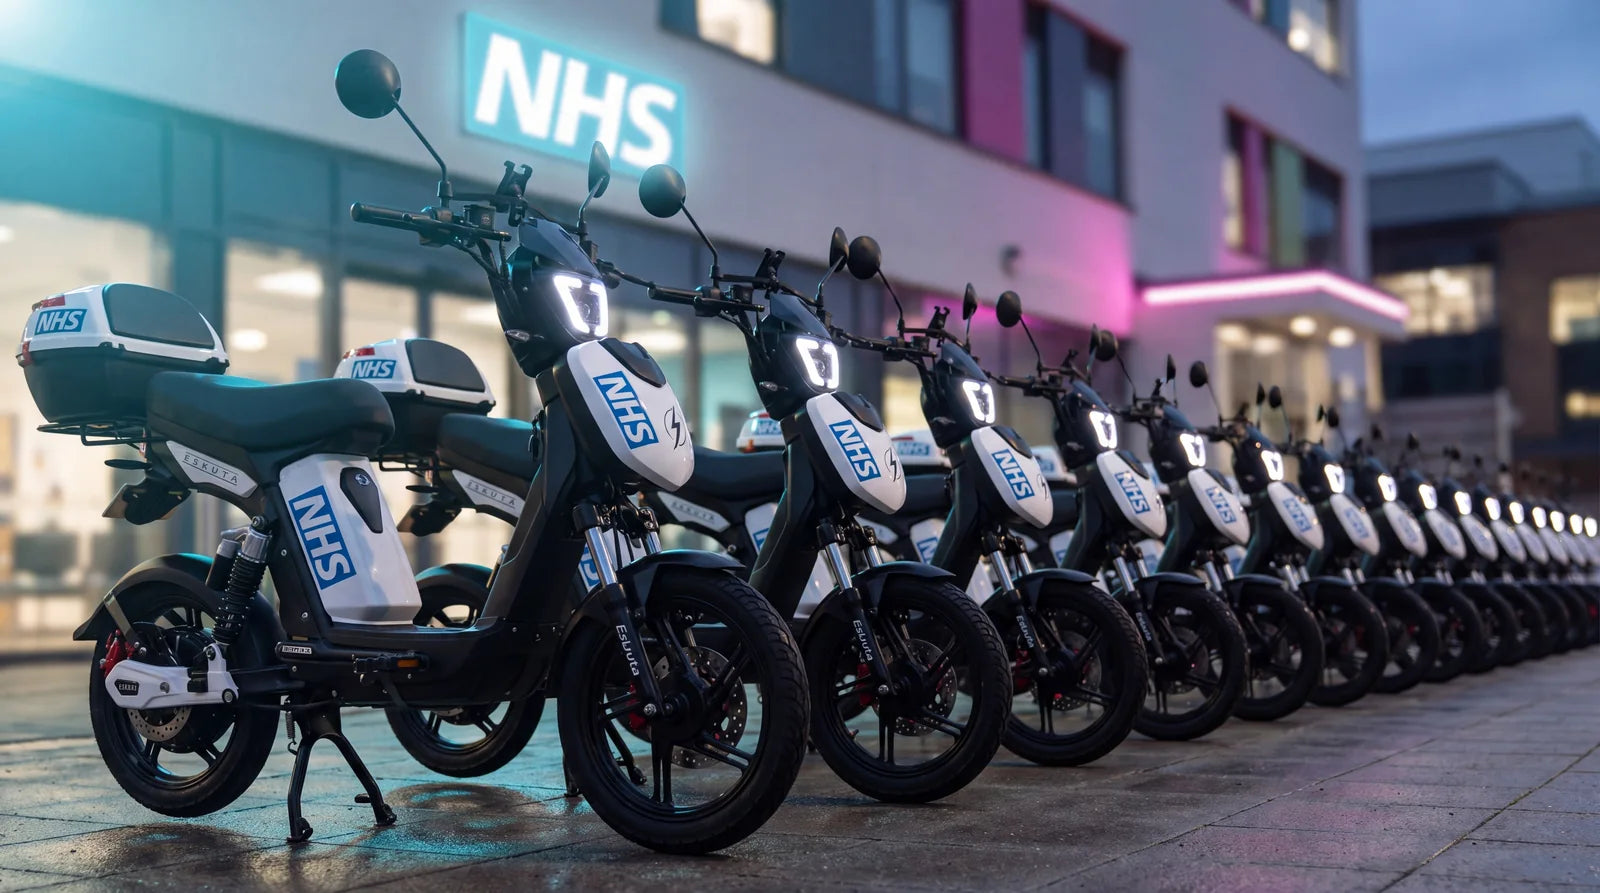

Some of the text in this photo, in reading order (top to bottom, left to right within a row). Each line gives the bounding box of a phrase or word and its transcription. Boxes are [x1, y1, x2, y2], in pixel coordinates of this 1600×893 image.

[475, 32, 677, 170] NHS
[36, 310, 83, 333] NHS
[352, 360, 395, 378] NHS
[597, 376, 655, 443] NHS
[183, 454, 238, 484] ESKUTA
[832, 424, 878, 477] NHS
[466, 481, 516, 506] ESKUTA
[994, 452, 1033, 497] NHS
[1115, 472, 1149, 512] NHS
[1208, 487, 1235, 523] NHS
[293, 494, 351, 581] NHS
